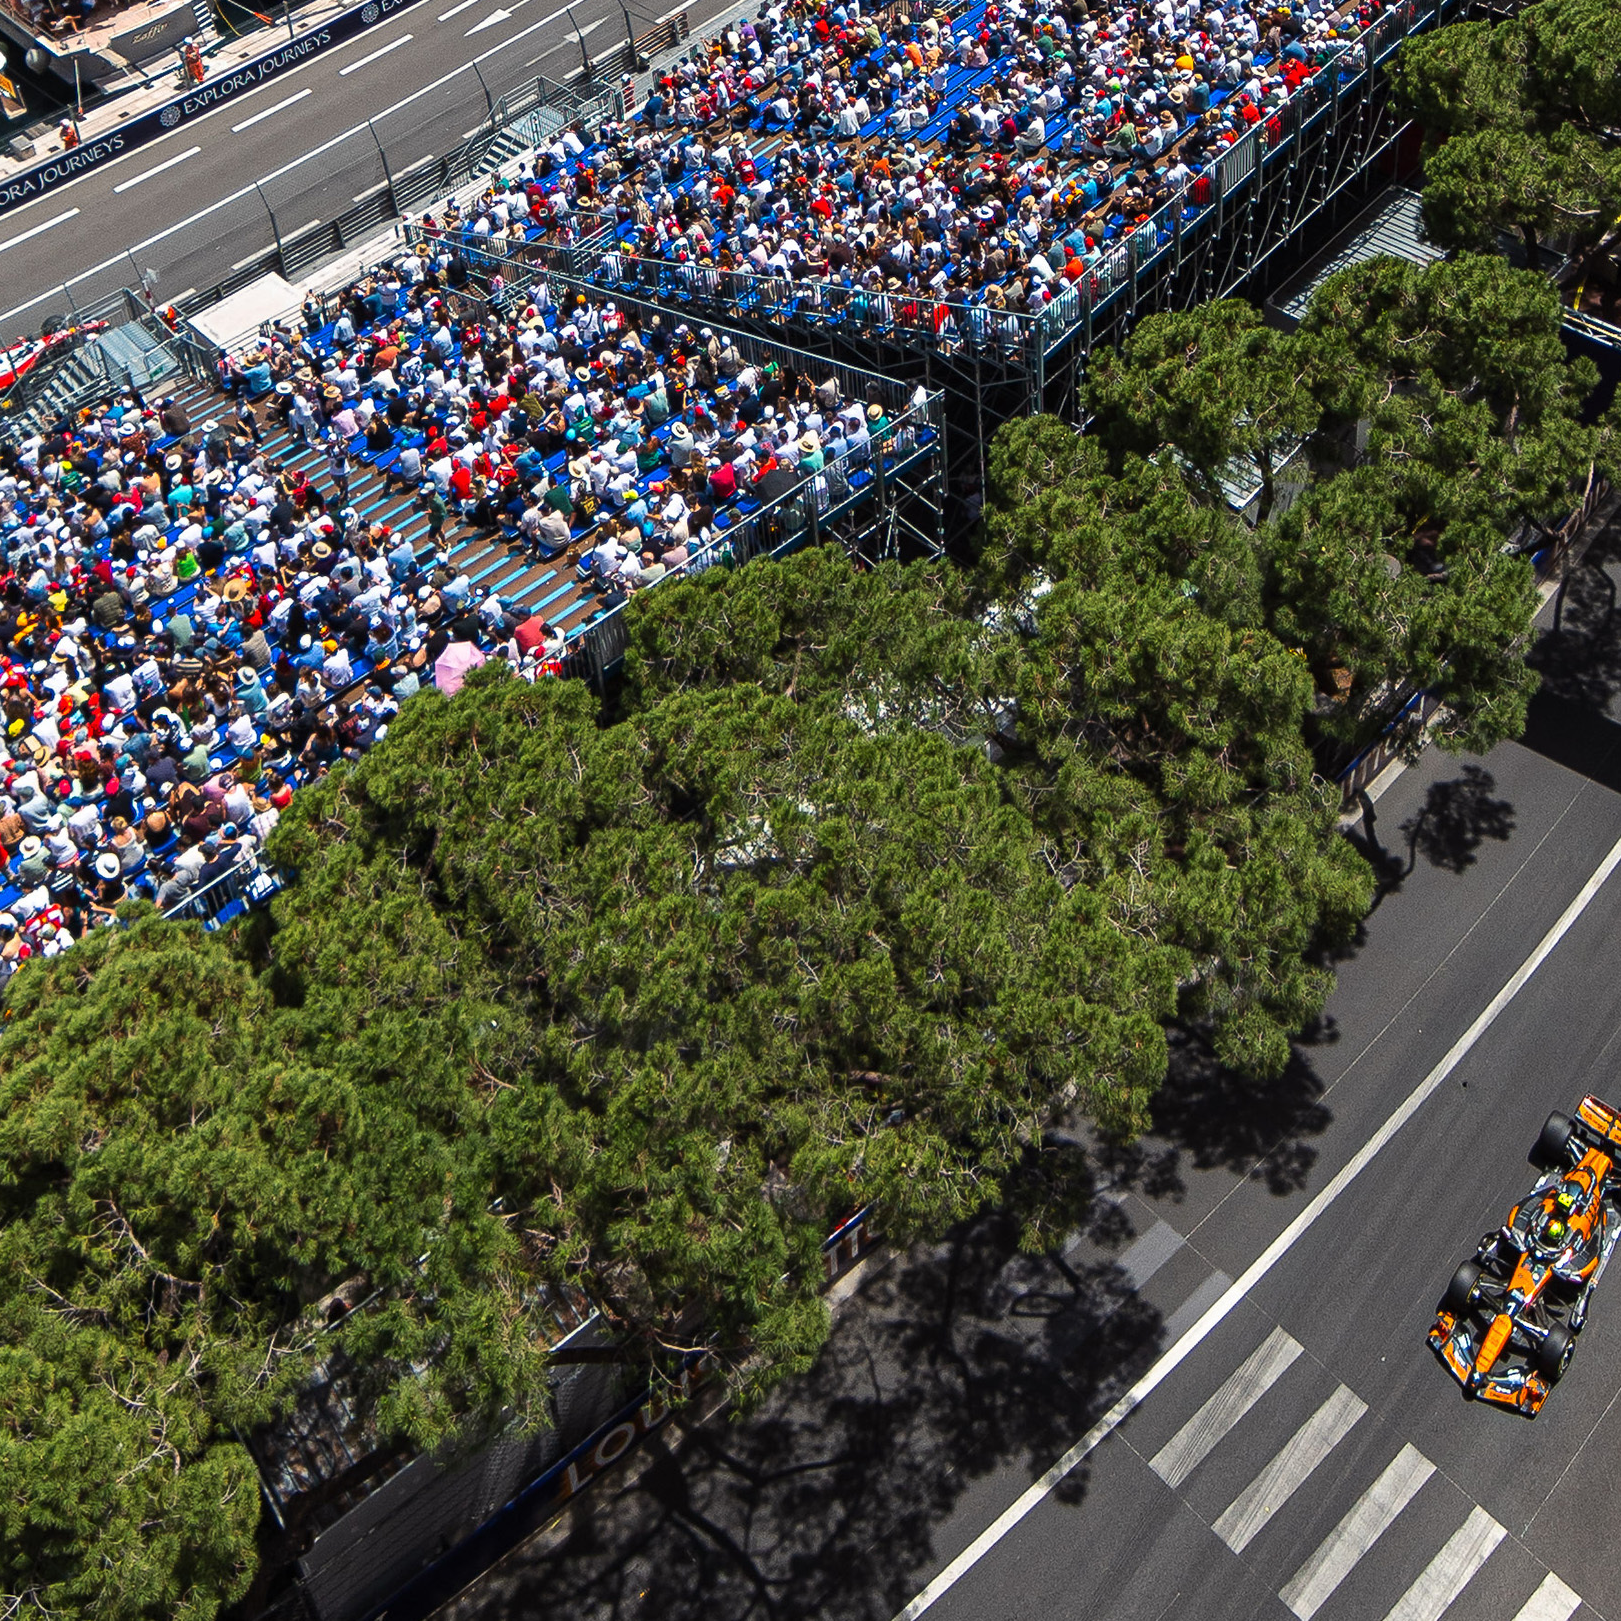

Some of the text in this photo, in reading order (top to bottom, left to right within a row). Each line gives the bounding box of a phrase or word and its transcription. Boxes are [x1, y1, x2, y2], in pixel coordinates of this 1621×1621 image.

[179, 28, 333, 115] EXPLORA JOURNEYS
[37, 133, 126, 189] JOURNEYS
